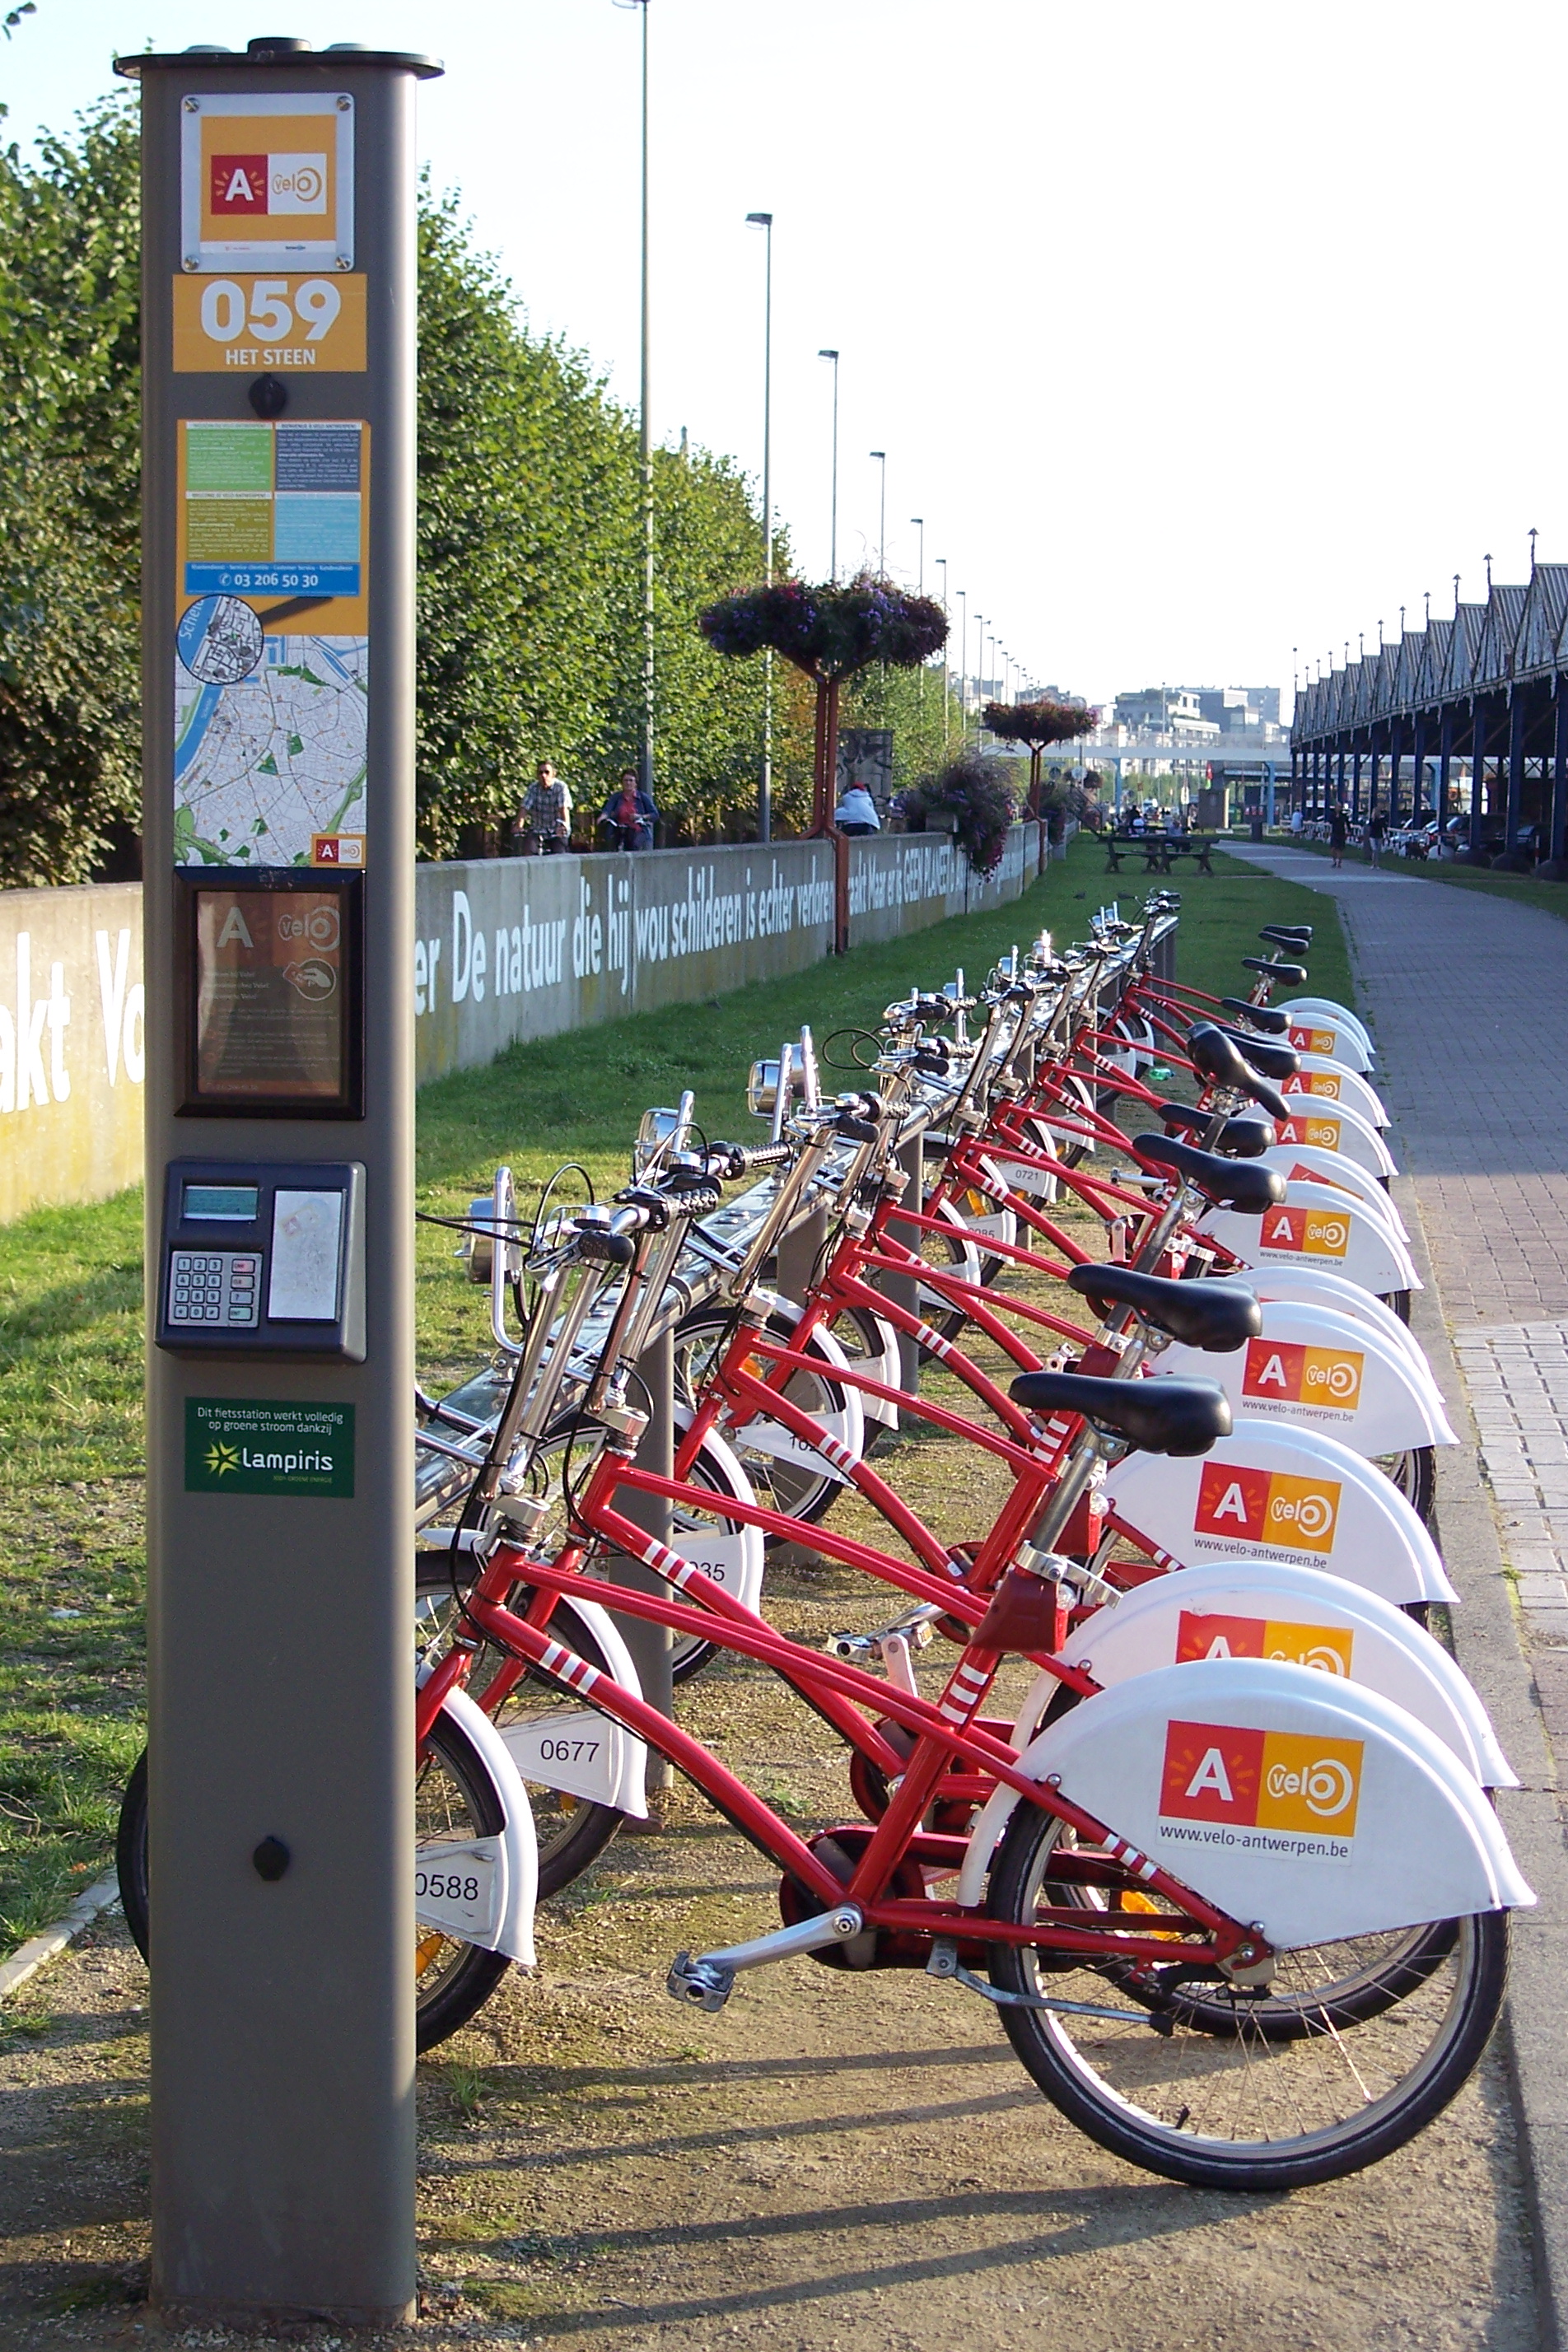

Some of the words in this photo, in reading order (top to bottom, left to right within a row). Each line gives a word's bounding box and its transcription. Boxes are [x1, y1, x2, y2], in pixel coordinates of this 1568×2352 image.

[225, 169, 254, 201] A
[201, 279, 341, 342] 059
[225, 349, 259, 365] HET
[263, 349, 316, 365] STEEN
[234, 574, 250, 587] 03
[254, 572, 278, 586] 206
[282, 574, 298, 588] 50
[302, 575, 319, 588] 30
[321, 844, 334, 857] A
[905, 847, 922, 903] GEEN
[217, 907, 254, 947] A
[453, 890, 487, 1003] De
[496, 904, 567, 996] natuur
[573, 876, 602, 979] die
[608, 874, 629, 995] hij
[635, 905, 668, 964] wou
[671, 865, 741, 958] schilderen
[745, 867, 755, 940] is
[758, 858, 795, 938] echter
[797, 855, 834, 928] verloren
[1294, 1033, 1305, 1046] A
[1289, 1077, 1303, 1093] A
[1281, 1122, 1297, 1141] A
[1015, 1170, 1039, 1180] 0721
[1272, 1216, 1293, 1241] A
[1259, 1250, 1344, 1267] www.velo-antwerpen.be
[1258, 1355, 1287, 1387] A
[1306, 1362, 1358, 1398] velo
[198, 1407, 212, 1417] Dit
[215, 1408, 271, 1420] fietsstation
[273, 1409, 302, 1421] werkt
[304, 1412, 343, 1424] volledig
[1242, 1400, 1354, 1422] www.velo-antwerpen.be
[208, 1421, 222, 1430] op
[223, 1422, 259, 1431] groene
[260, 1423, 295, 1432] stroom
[296, 1423, 332, 1435] dankzij
[790, 1434, 816, 1452] 10
[1212, 1483, 1248, 1523] A
[1270, 1494, 1333, 1537] velo
[1194, 1538, 1328, 1569] www.velo-antwerpen.be
[540, 1739, 600, 1762] 0677
[1185, 1748, 1234, 1802] A
[1267, 1758, 1354, 1817] velo
[1160, 1824, 1348, 1858] www.velo-antwerpen.be
[415, 1873, 478, 1900] 0588
